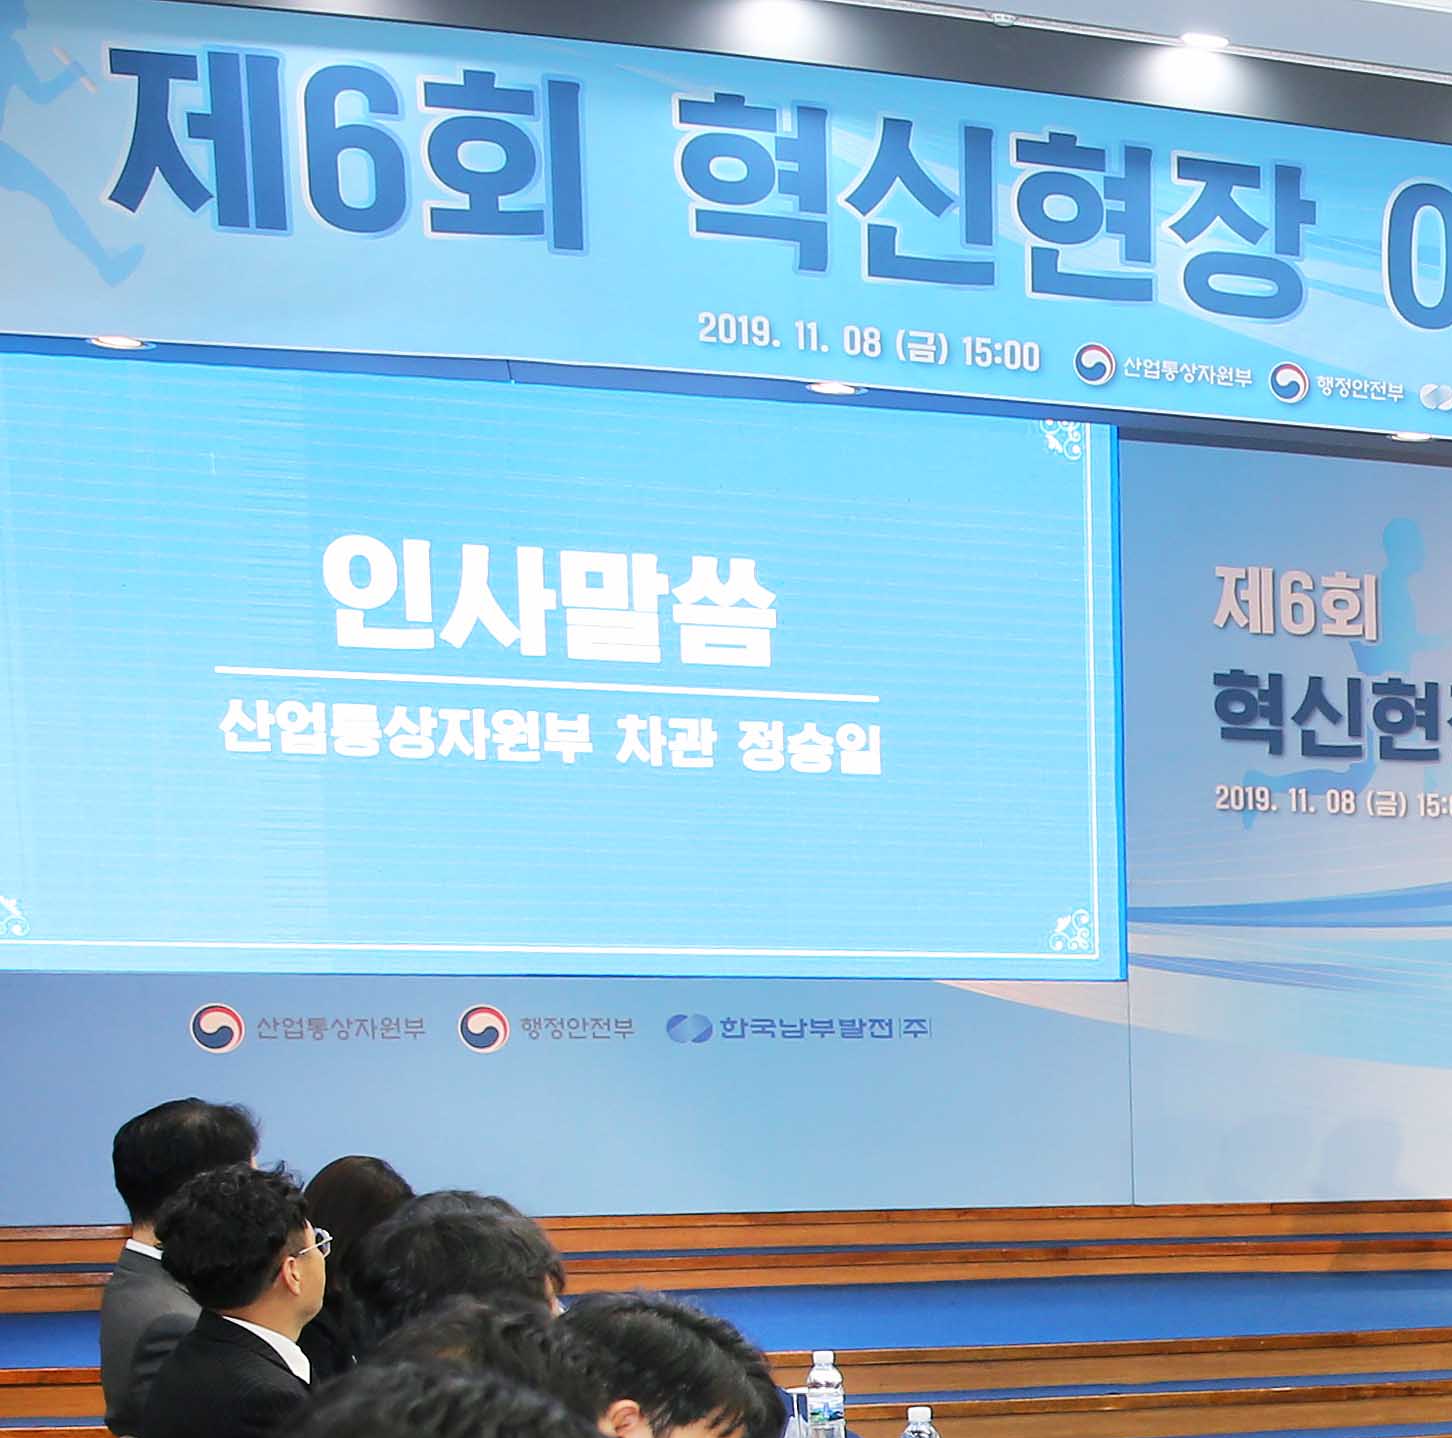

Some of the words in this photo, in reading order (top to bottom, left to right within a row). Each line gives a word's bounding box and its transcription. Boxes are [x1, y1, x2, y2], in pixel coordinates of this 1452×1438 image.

[106, 47, 584, 254] 제6회
[676, 92, 1316, 318] 혁신현장
[698, 311, 781, 349] 2019.
[795, 320, 831, 353] 11.
[843, 323, 883, 358] 08
[895, 328, 951, 367] (금)
[962, 335, 1042, 373] 15:00
[1123, 357, 1253, 388] 산업통상자원부
[1316, 374, 1405, 403] 행정안전부
[321, 533, 777, 668] 인사말씀
[1213, 565, 1378, 641] 제6회
[218, 698, 593, 763] 산업통상자원부
[615, 713, 717, 769] 차관
[1215, 785, 1277, 812] 2019.
[1287, 788, 1315, 814] 11.
[1326, 789, 1356, 815] 08
[1366, 790, 1407, 820] (금)
[256, 1016, 426, 1041] 산업통상자원부
[520, 1016, 636, 1041] 행정안전부
